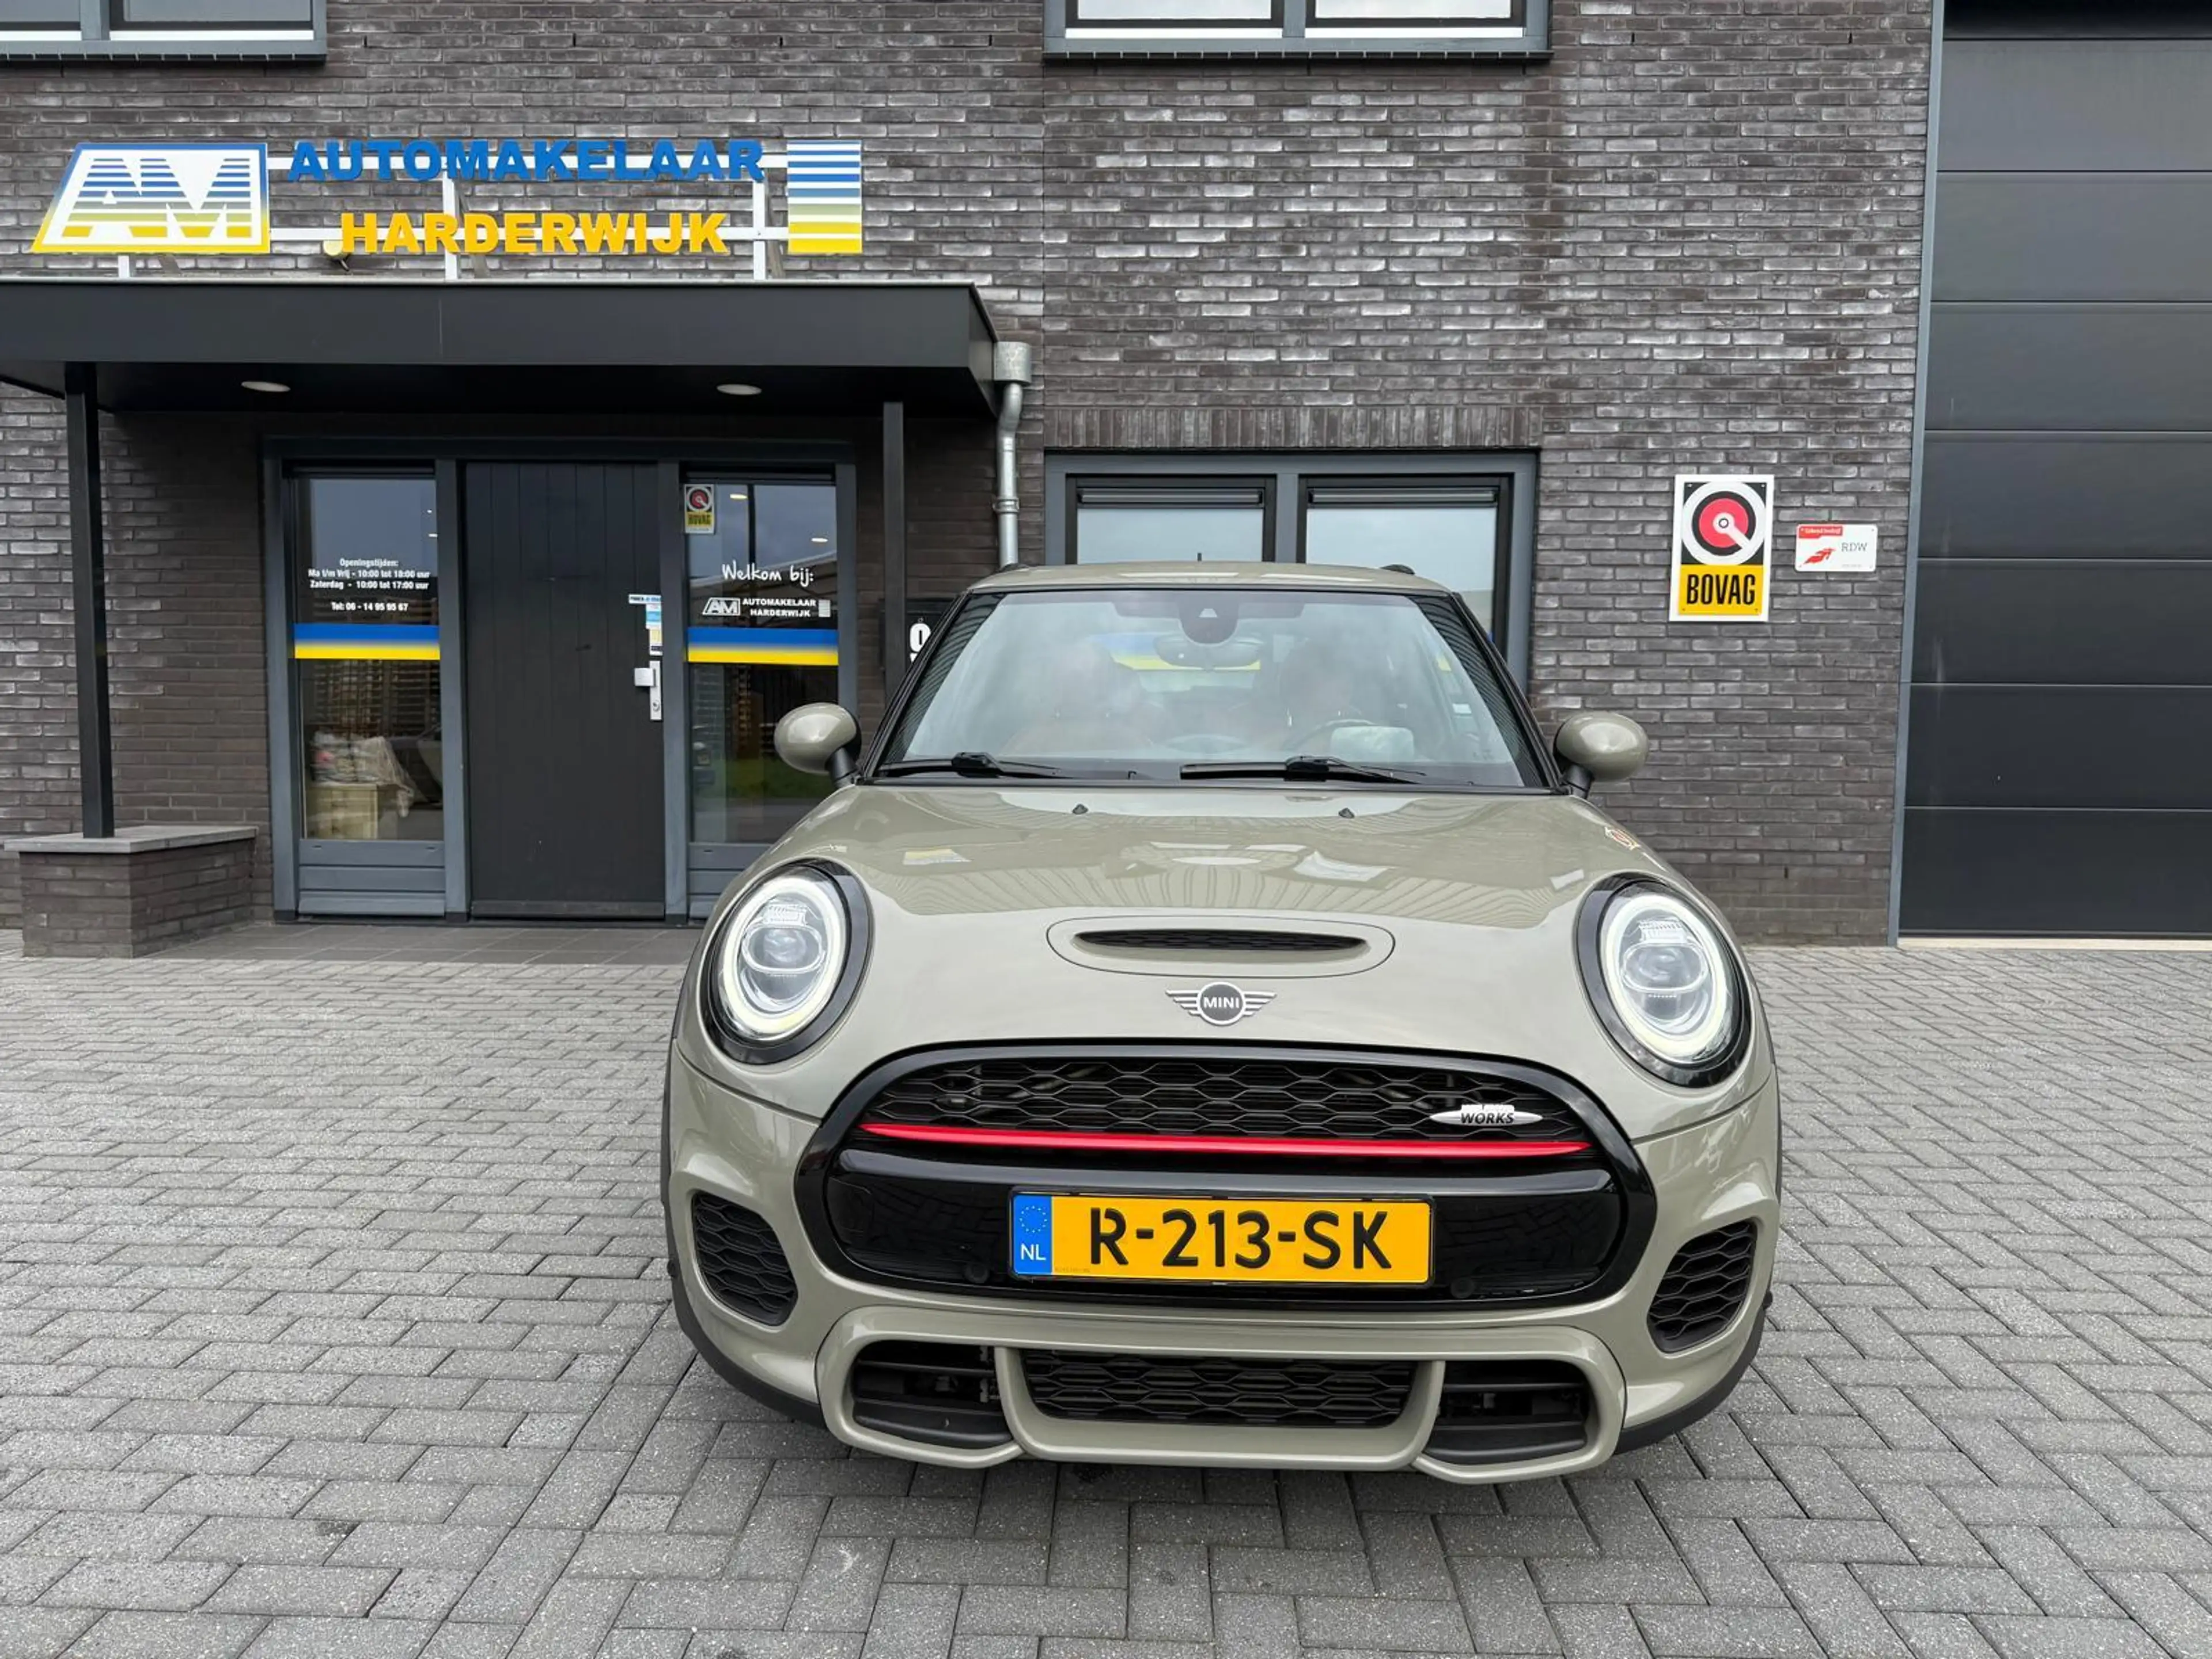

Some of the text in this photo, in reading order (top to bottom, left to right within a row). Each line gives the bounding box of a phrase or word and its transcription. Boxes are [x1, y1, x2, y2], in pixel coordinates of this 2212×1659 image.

[288, 139, 765, 182] AUTOMAKELAAR
[62, 158, 252, 237] AM
[341, 212, 730, 254] HARDERWIJK
[1841, 542, 1868, 552] RDW
[339, 558, 399, 569] Openingstijden:
[358, 569, 379, 578] 10:00
[722, 559, 814, 587] Welkom bij:
[310, 580, 344, 590] Zaterdag
[357, 580, 378, 589] 10:00
[392, 580, 414, 589] 17:00
[1685, 574, 1756, 605] BOVAG
[709, 599, 738, 614] AM
[742, 597, 816, 607] AUTOMAKELAAR
[750, 608, 811, 618] HARDERWIJK
[1203, 997, 1239, 1009] MINI
[1461, 1112, 1515, 1124] WORKS
[1020, 1207, 1392, 1269] NL R-213-SK
